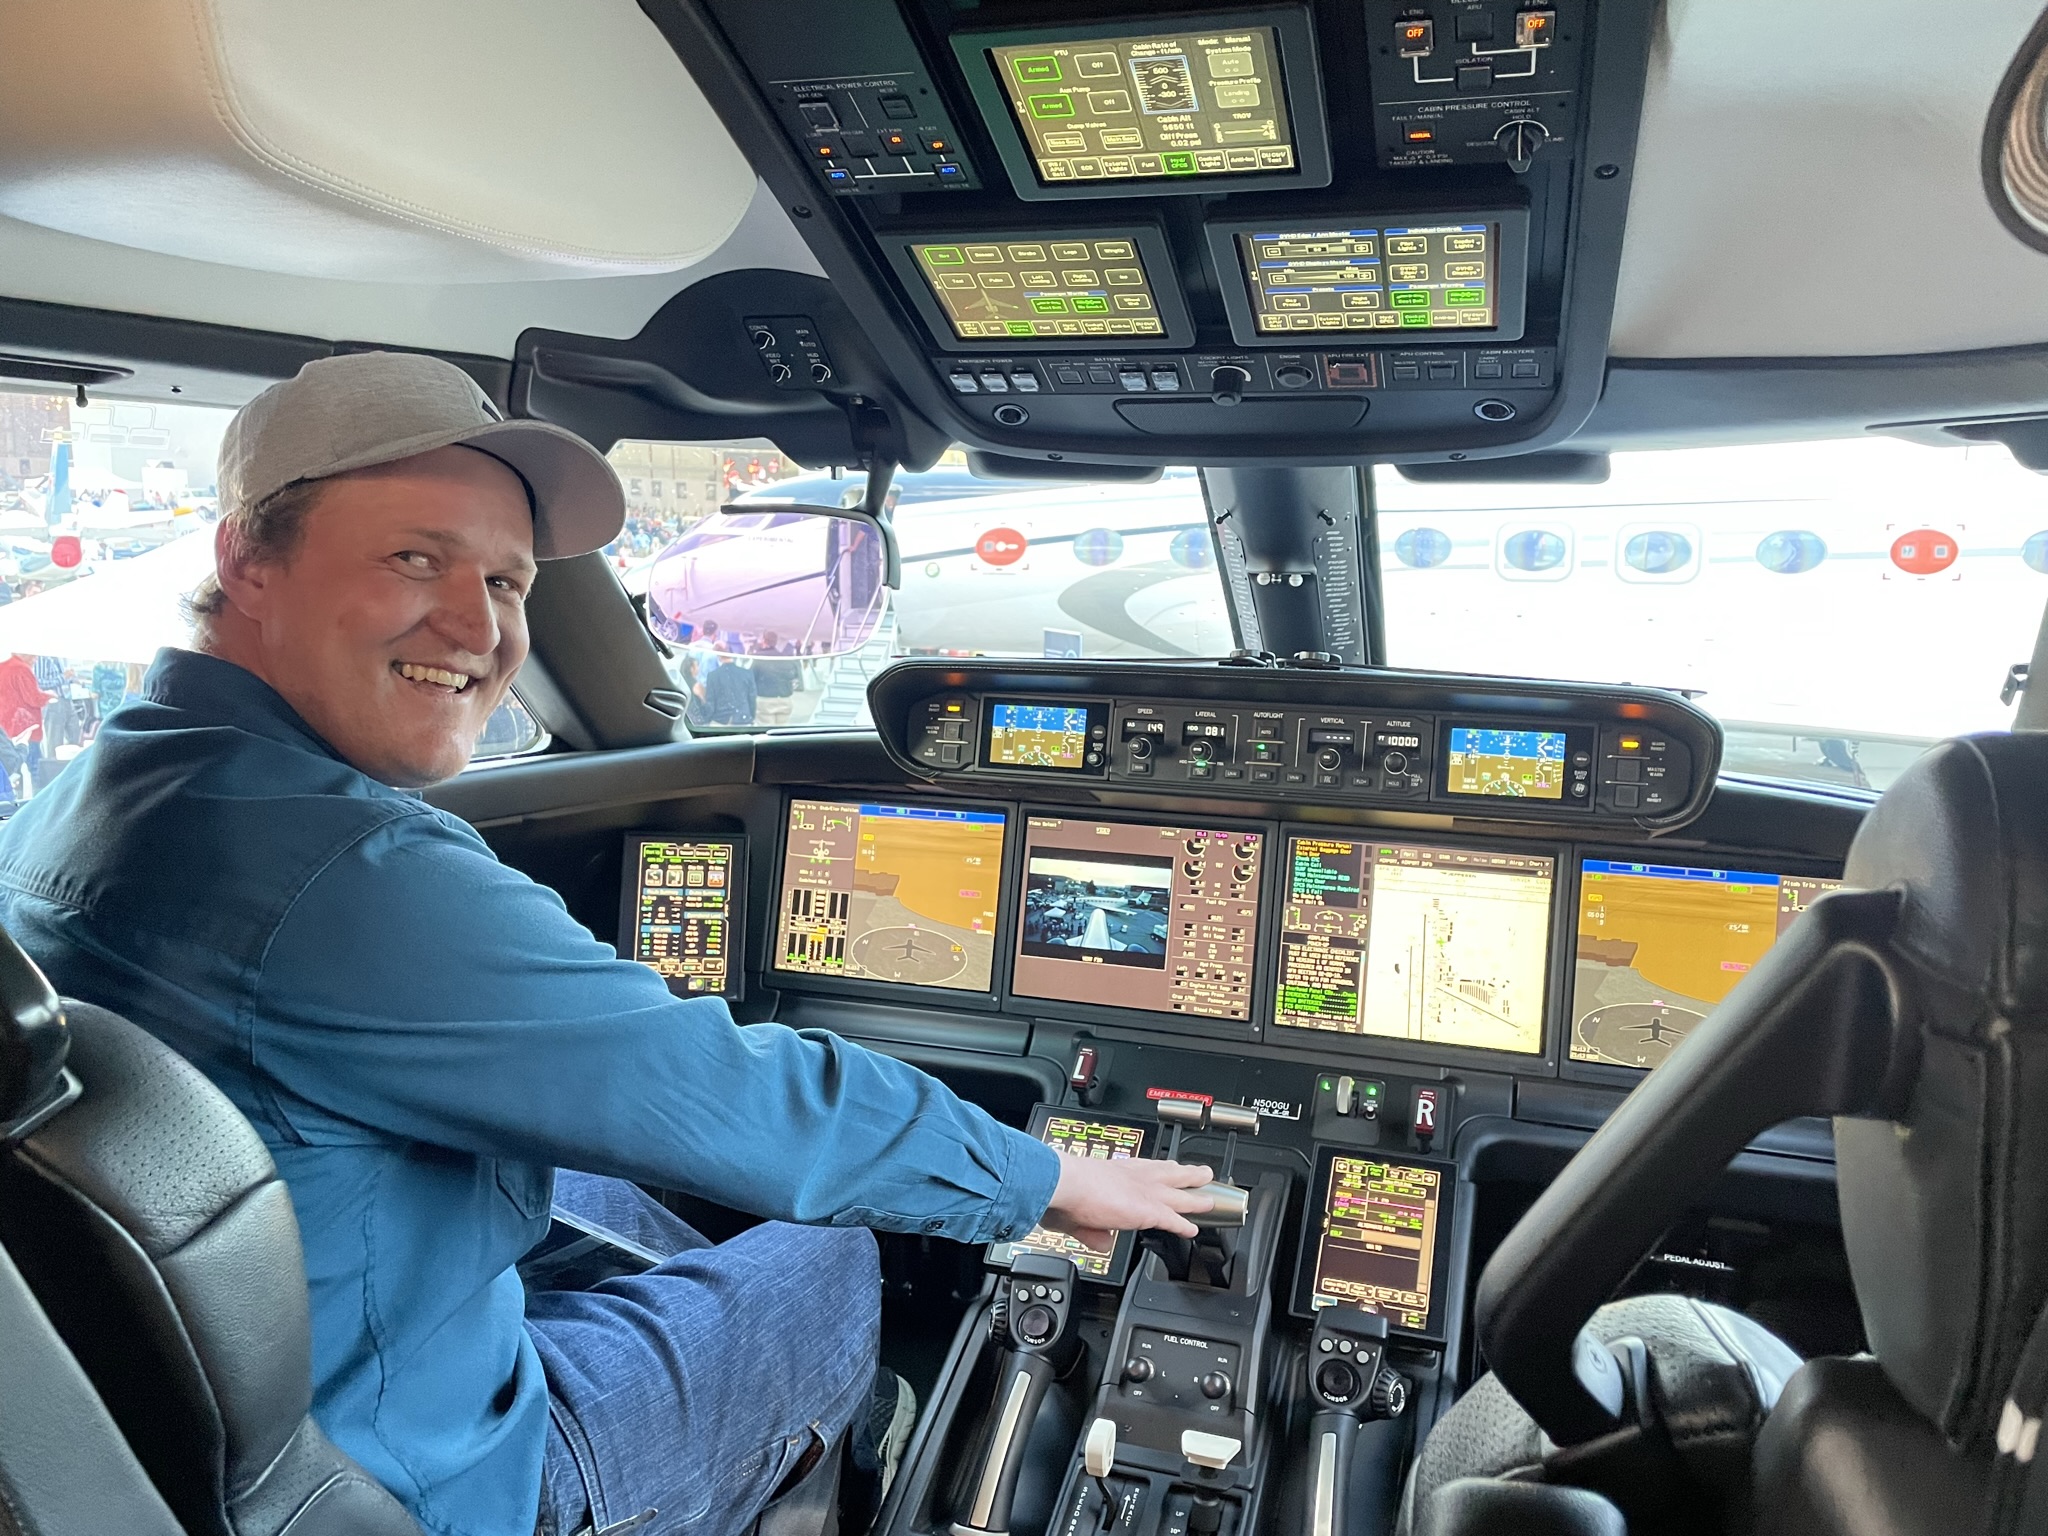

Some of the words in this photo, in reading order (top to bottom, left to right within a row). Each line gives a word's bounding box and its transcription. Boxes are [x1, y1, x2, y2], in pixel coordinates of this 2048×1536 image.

[1527, 19, 1545, 28] OFF
[1407, 28, 1424, 38] OFF
[793, 84, 836, 92] ELECTRICAL
[836, 81, 862, 90] POWER
[863, 80, 899, 88] CONTROL
[1445, 103, 1488, 111] PRESSURE
[1491, 100, 1531, 108] CONTROL
[1147, 723, 1163, 732] 149
[1388, 736, 1418, 747] 10000
[1637, 1055, 1646, 1063] W
[1073, 1055, 1085, 1079] L
[1253, 1098, 1290, 1111] N500GU
[1416, 1099, 1434, 1126] R
[1664, 1253, 1692, 1264] PEDAL
[1692, 1258, 1725, 1269] ADJUST
[1024, 1335, 1045, 1345] CURSOR
[1164, 1334, 1178, 1343] FUEL
[1180, 1338, 1209, 1349] CONTROL
[1323, 1391, 1348, 1402] CURSOR
[1125, 1487, 1140, 1527] RETRACT
